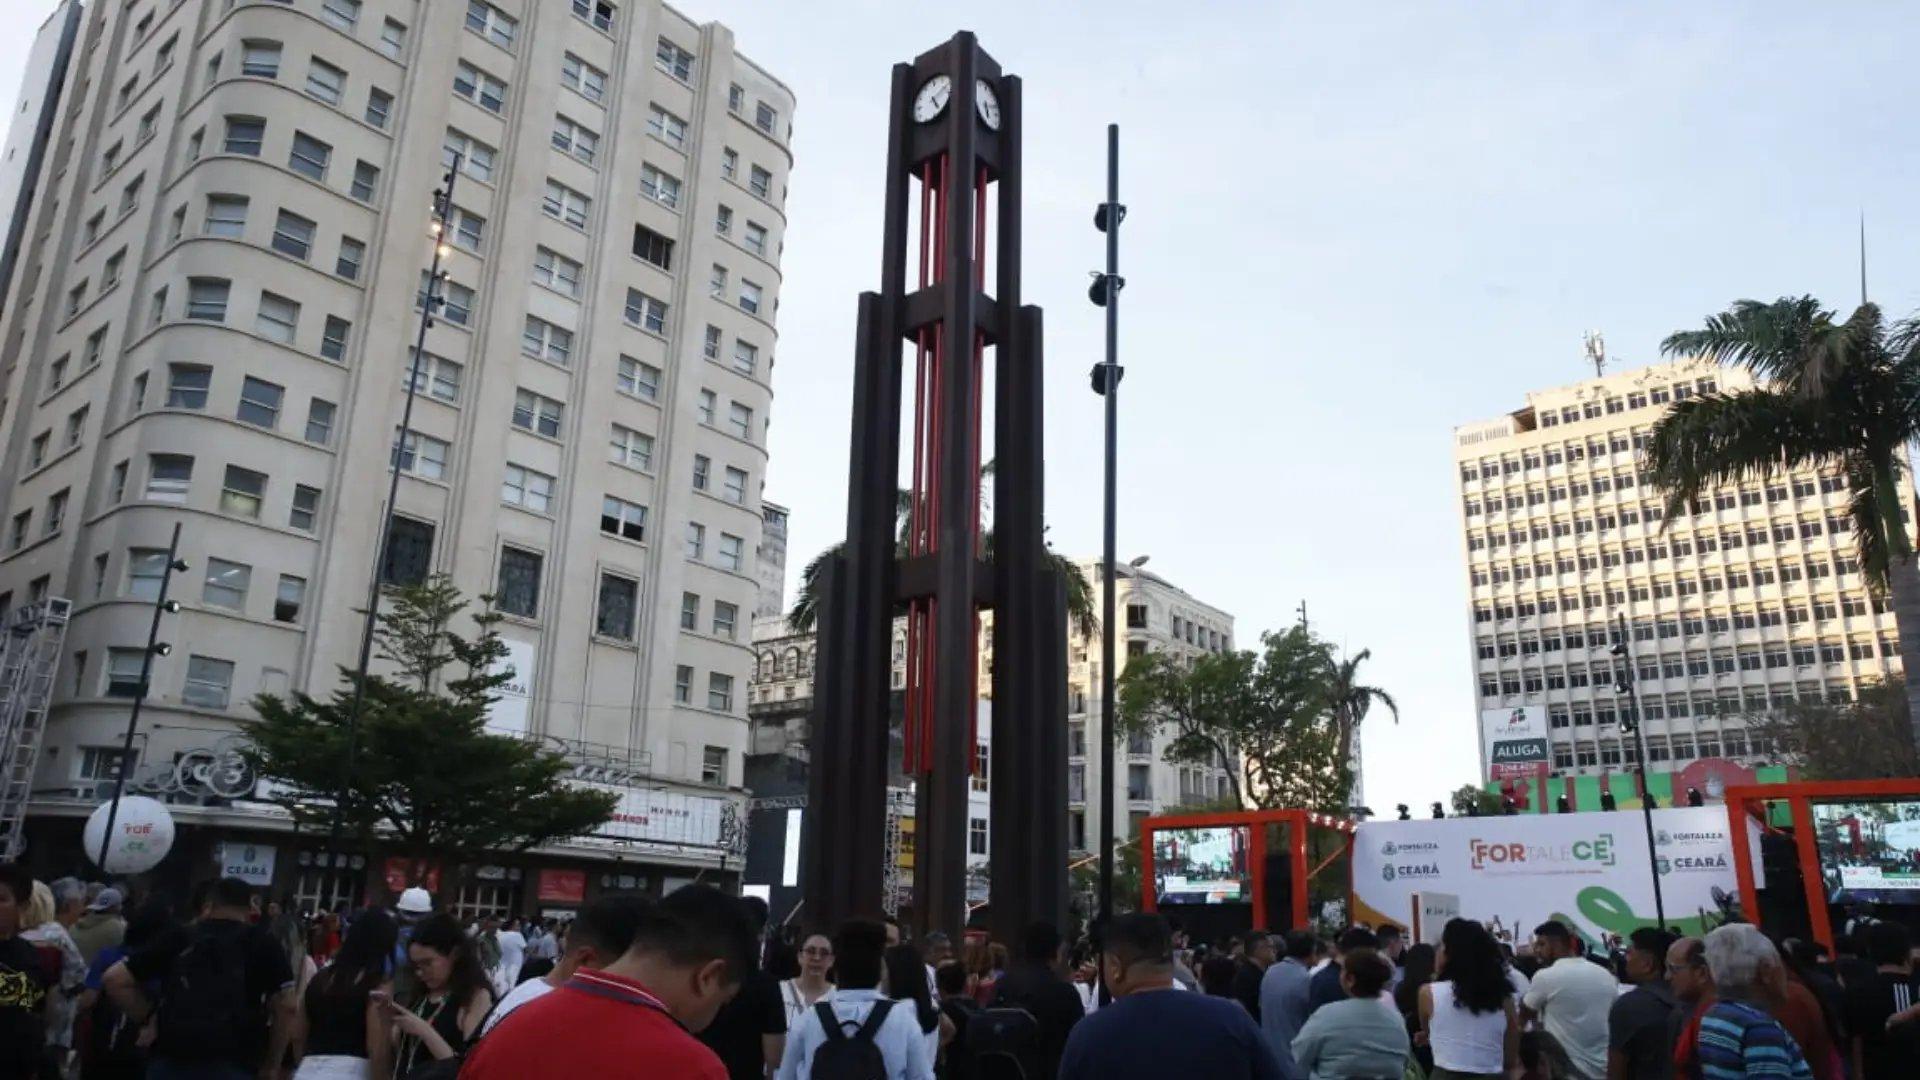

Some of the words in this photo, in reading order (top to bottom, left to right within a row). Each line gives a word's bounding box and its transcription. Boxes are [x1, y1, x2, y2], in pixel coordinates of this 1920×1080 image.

[1496, 744, 1541, 757] ALUGA
[1674, 853, 1727, 868] CEARÁ
[1398, 861, 1440, 875] CEARÁ
